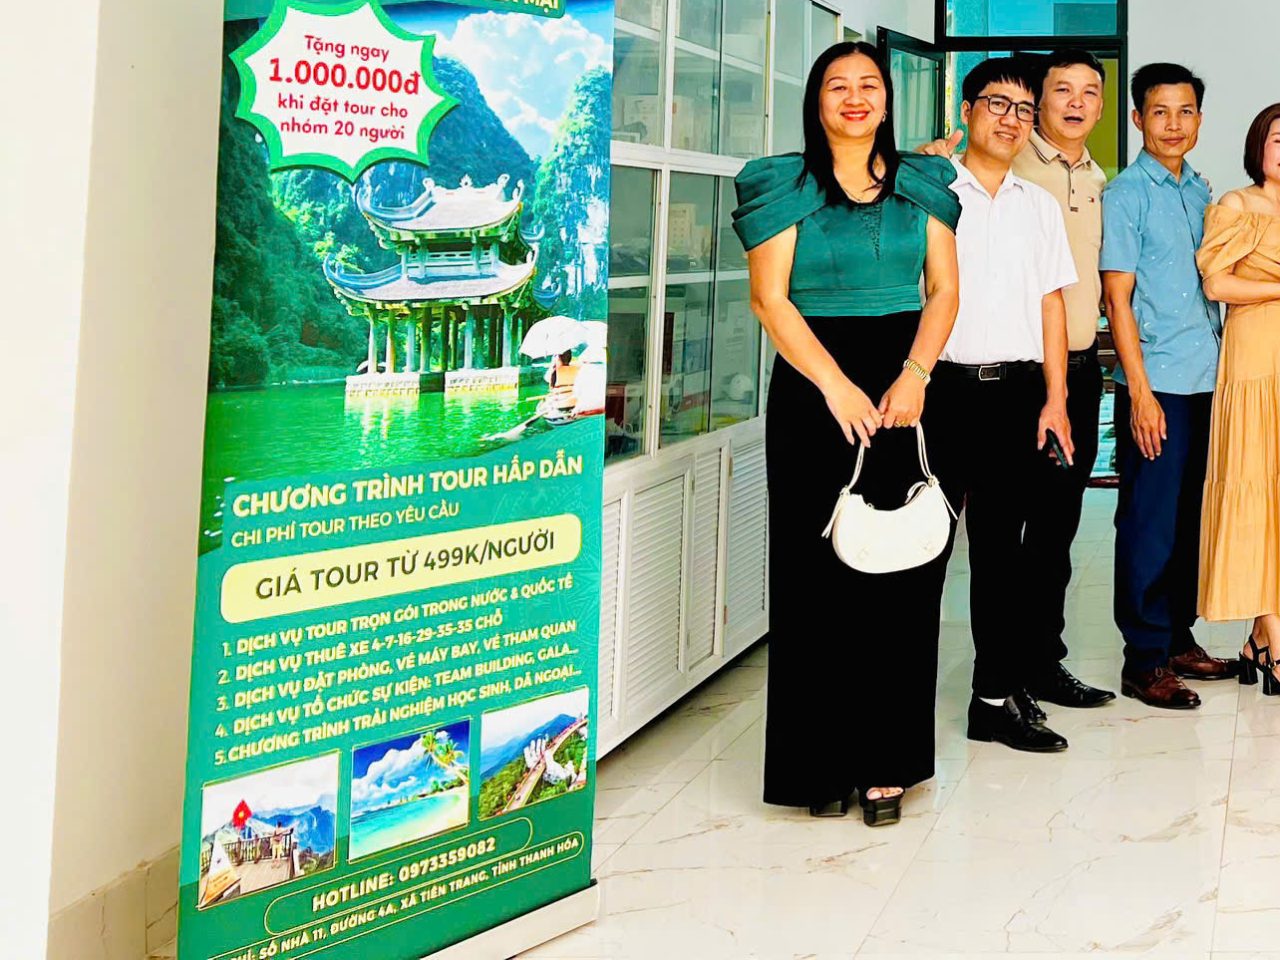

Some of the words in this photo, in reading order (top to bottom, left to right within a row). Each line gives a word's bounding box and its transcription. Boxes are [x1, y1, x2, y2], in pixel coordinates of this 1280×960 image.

[304, 34, 345, 59] Tặng
[350, 43, 390, 63] ngay
[268, 57, 421, 95] 1.000.000đ
[277, 93, 304, 110] khi
[309, 95, 339, 116] đặt
[343, 98, 375, 116] tour
[380, 101, 408, 118] cho
[280, 117, 328, 134] nhóm
[334, 120, 354, 136] 20
[359, 124, 405, 143] người
[232, 483, 347, 518] CHƯƠNG
[352, 472, 424, 502] TRÌNH
[429, 466, 488, 492] TOUR
[492, 454, 535, 485] HẤP
[538, 448, 583, 479] DẪN
[231, 528, 262, 548] CHI
[265, 521, 296, 542] PHÍ
[300, 518, 345, 538] TOUR
[349, 512, 392, 531] THEO
[395, 505, 425, 524] YÊU
[428, 499, 460, 519] CẦU
[255, 567, 301, 600] GIÁ
[310, 560, 378, 591] TOUR
[387, 550, 418, 577] TỪ
[424, 530, 555, 571] 499K/NGƯỜI
[236, 632, 277, 656] DỊCH
[279, 627, 303, 647] VỤ
[305, 620, 348, 640] TOUR
[350, 611, 391, 631] TRỌN
[393, 604, 419, 622] GÓI
[421, 596, 468, 617] TRONG
[470, 587, 508, 607] NƯỚC
[510, 587, 518, 600] &
[521, 576, 555, 599] QUỐC
[234, 685, 275, 709] DỊCH
[277, 680, 301, 699] VỤ
[396, 651, 416, 671] VÉ
[418, 646, 449, 666] MÁY
[483, 633, 501, 651] VÉ
[502, 627, 539, 647] THAM
[540, 619, 577, 639] QUAN
[235, 658, 276, 683] DỊCH
[278, 654, 302, 673] VỤ
[304, 642, 346, 666] THUÊ
[349, 640, 370, 657] XE
[233, 711, 274, 736] DỊCH
[276, 705, 300, 725] VỤ
[326, 690, 370, 712] CHỨC
[372, 682, 393, 703] SỰ
[434, 666, 472, 686] TEAM
[302, 719, 350, 743] TRÌNH
[352, 707, 387, 731] TRẢI
[389, 696, 445, 722] NGHIỆM
[447, 688, 477, 707] HỌC
[312, 873, 395, 912] HOTLINE:
[398, 837, 496, 882] 0973359082
[519, 846, 555, 866] THANH
[557, 837, 579, 853] HÓA
